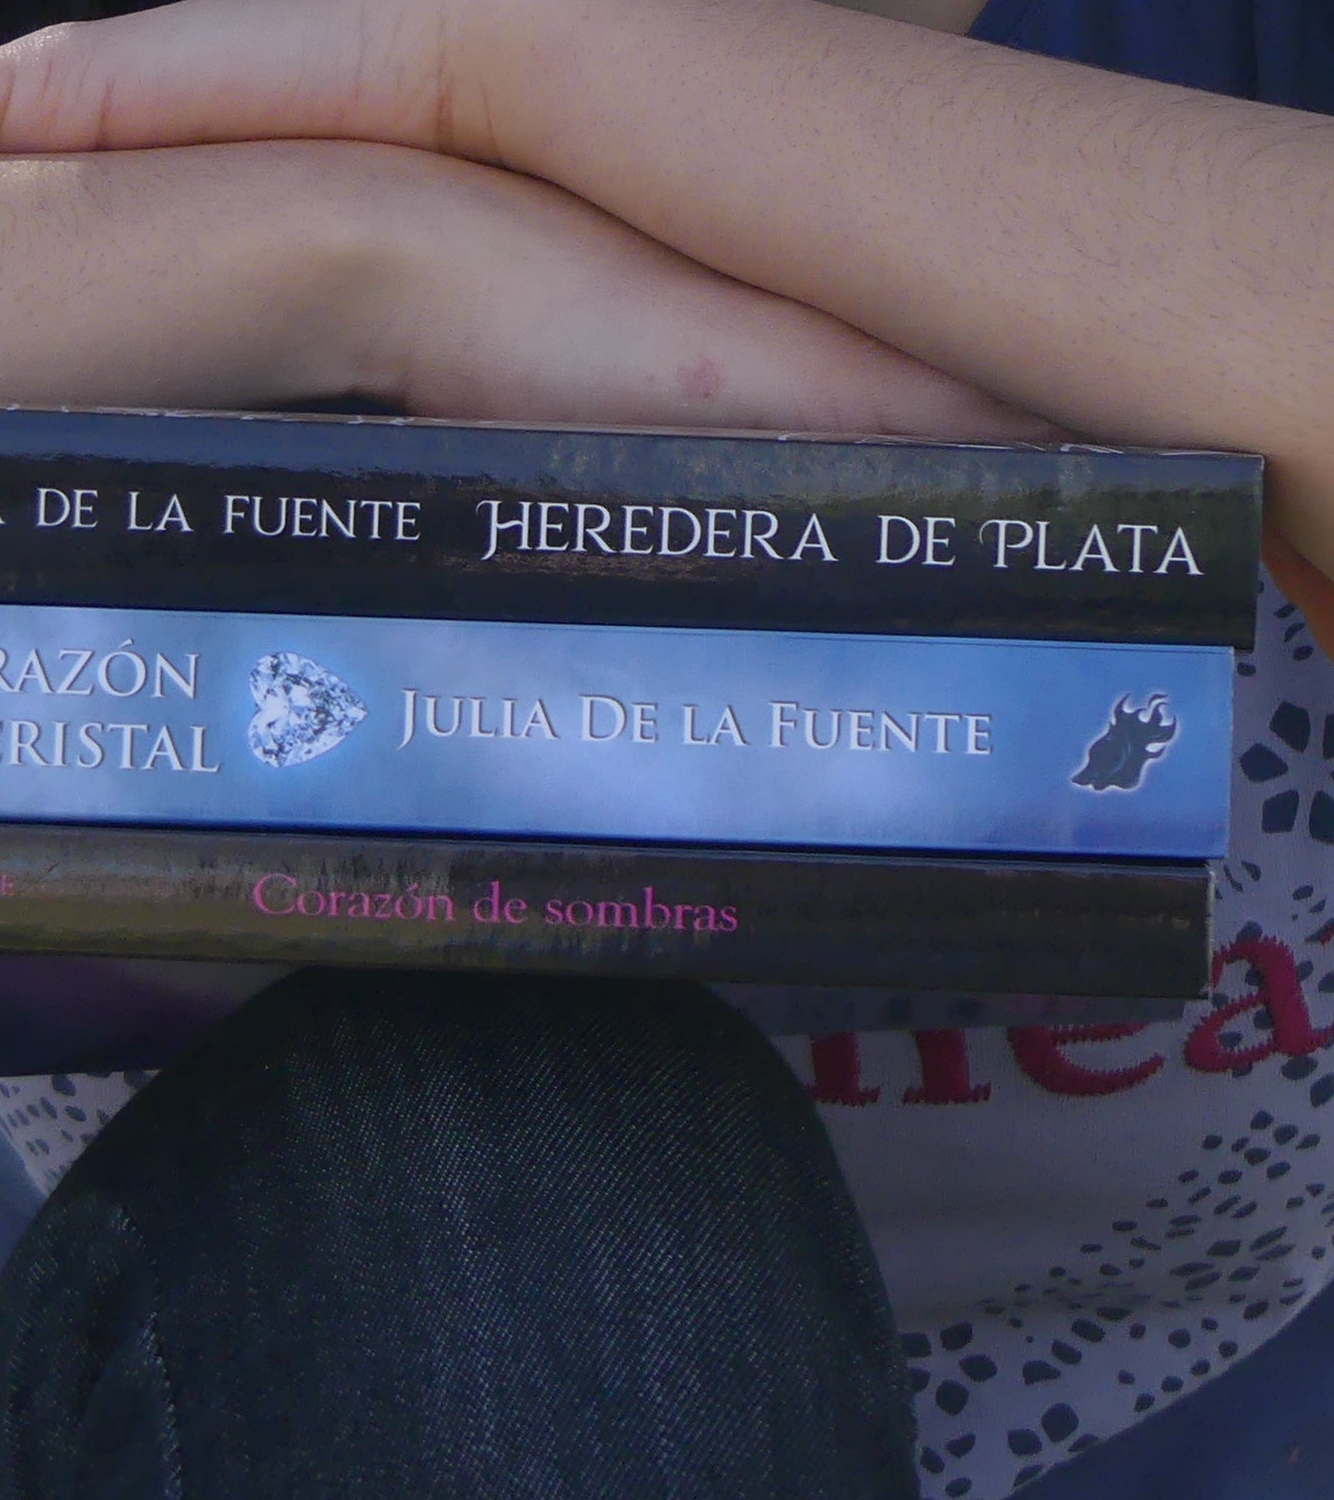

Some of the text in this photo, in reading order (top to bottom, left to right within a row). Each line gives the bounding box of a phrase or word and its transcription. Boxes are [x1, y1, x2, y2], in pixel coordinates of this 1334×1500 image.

[36, 487, 98, 528] DE
[127, 491, 194, 532] LA
[223, 494, 421, 541] FUENTE
[476, 500, 1205, 576] HEREDERA DE PLATA
[397, 688, 993, 756] JULIA DE LA FUENTE
[253, 873, 739, 932] Corazón de sombras
